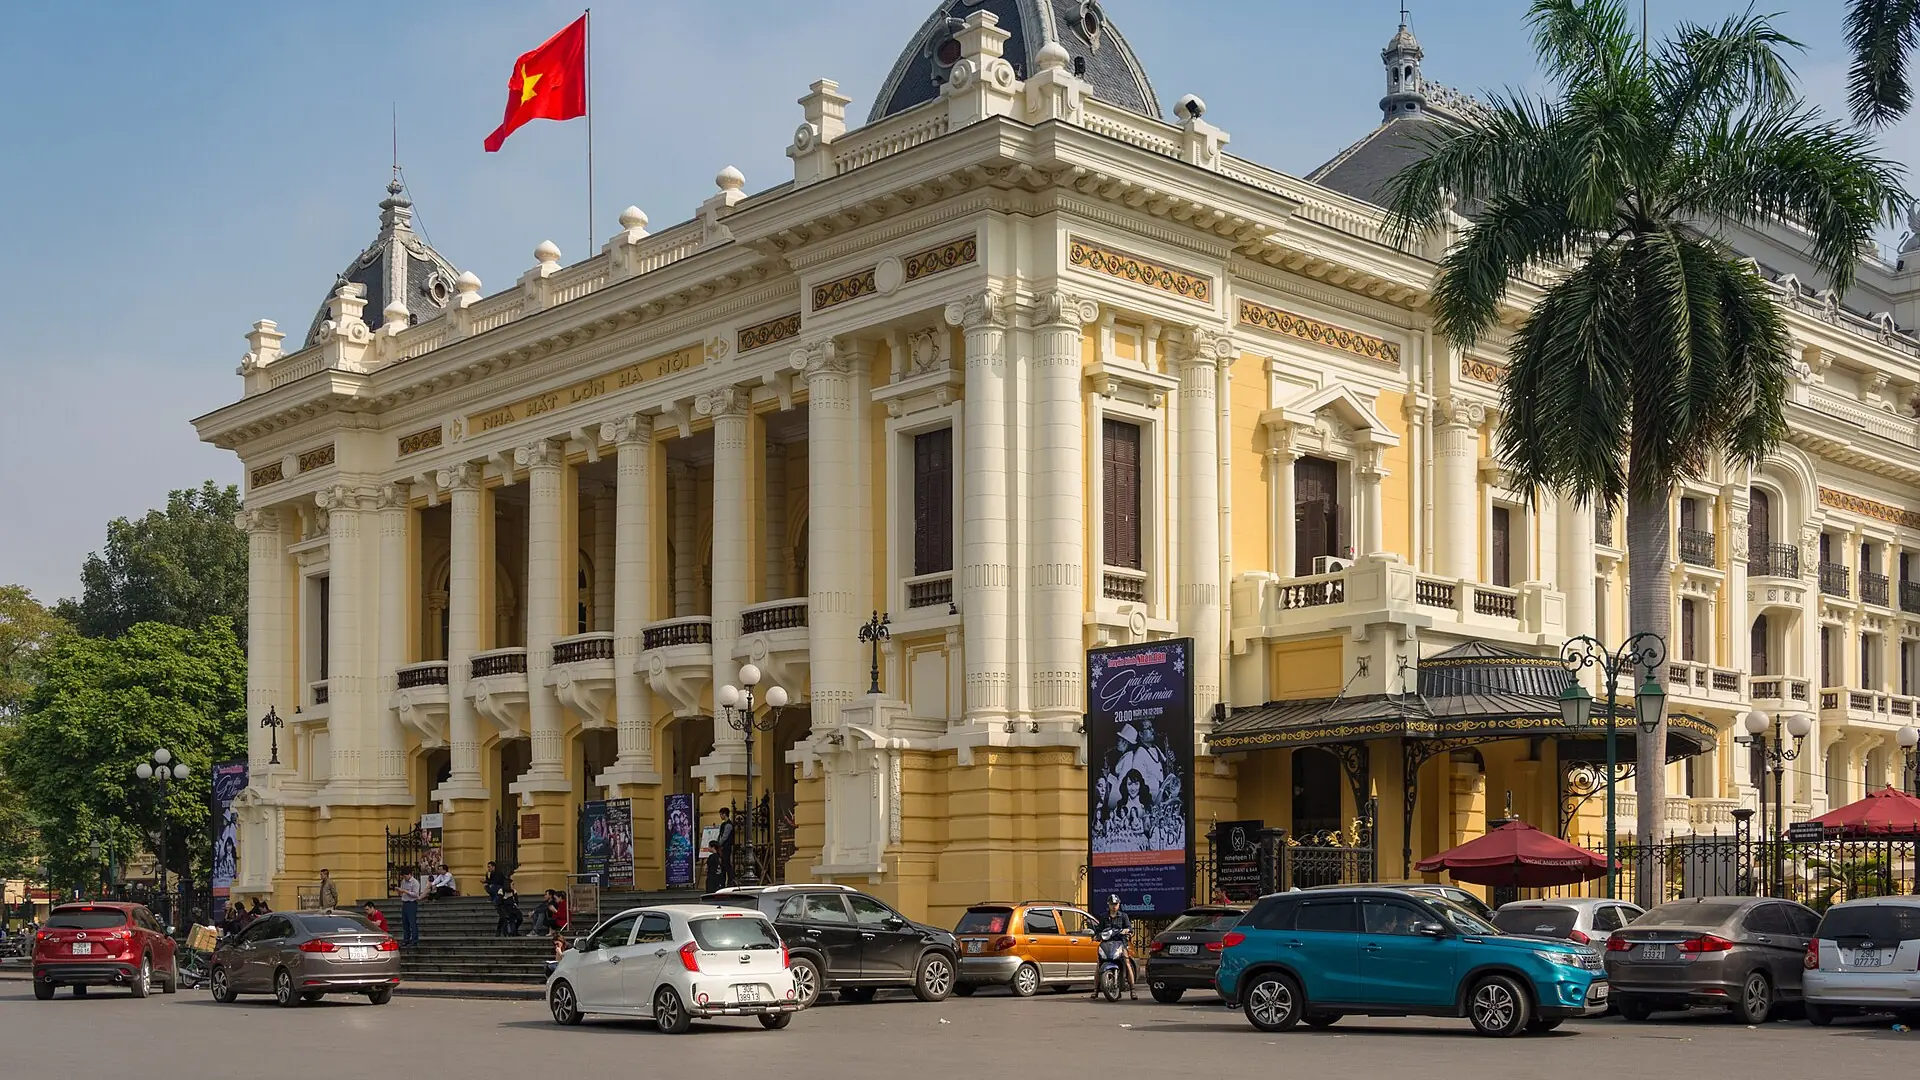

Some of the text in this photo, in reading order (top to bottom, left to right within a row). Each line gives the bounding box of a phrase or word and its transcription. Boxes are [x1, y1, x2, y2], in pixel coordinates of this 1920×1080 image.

[483, 352, 690, 430] NHÀ HÁT LỚN HÀ NỘI
[1100, 669, 1163, 712] Giai điệu
[1152, 687, 1174, 700] mùa
[1224, 854, 1248, 862] nineteen
[1559, 859, 1582, 867] COFFEE
[1860, 949, 1875, 958] 29D
[742, 985, 754, 993] 30E
